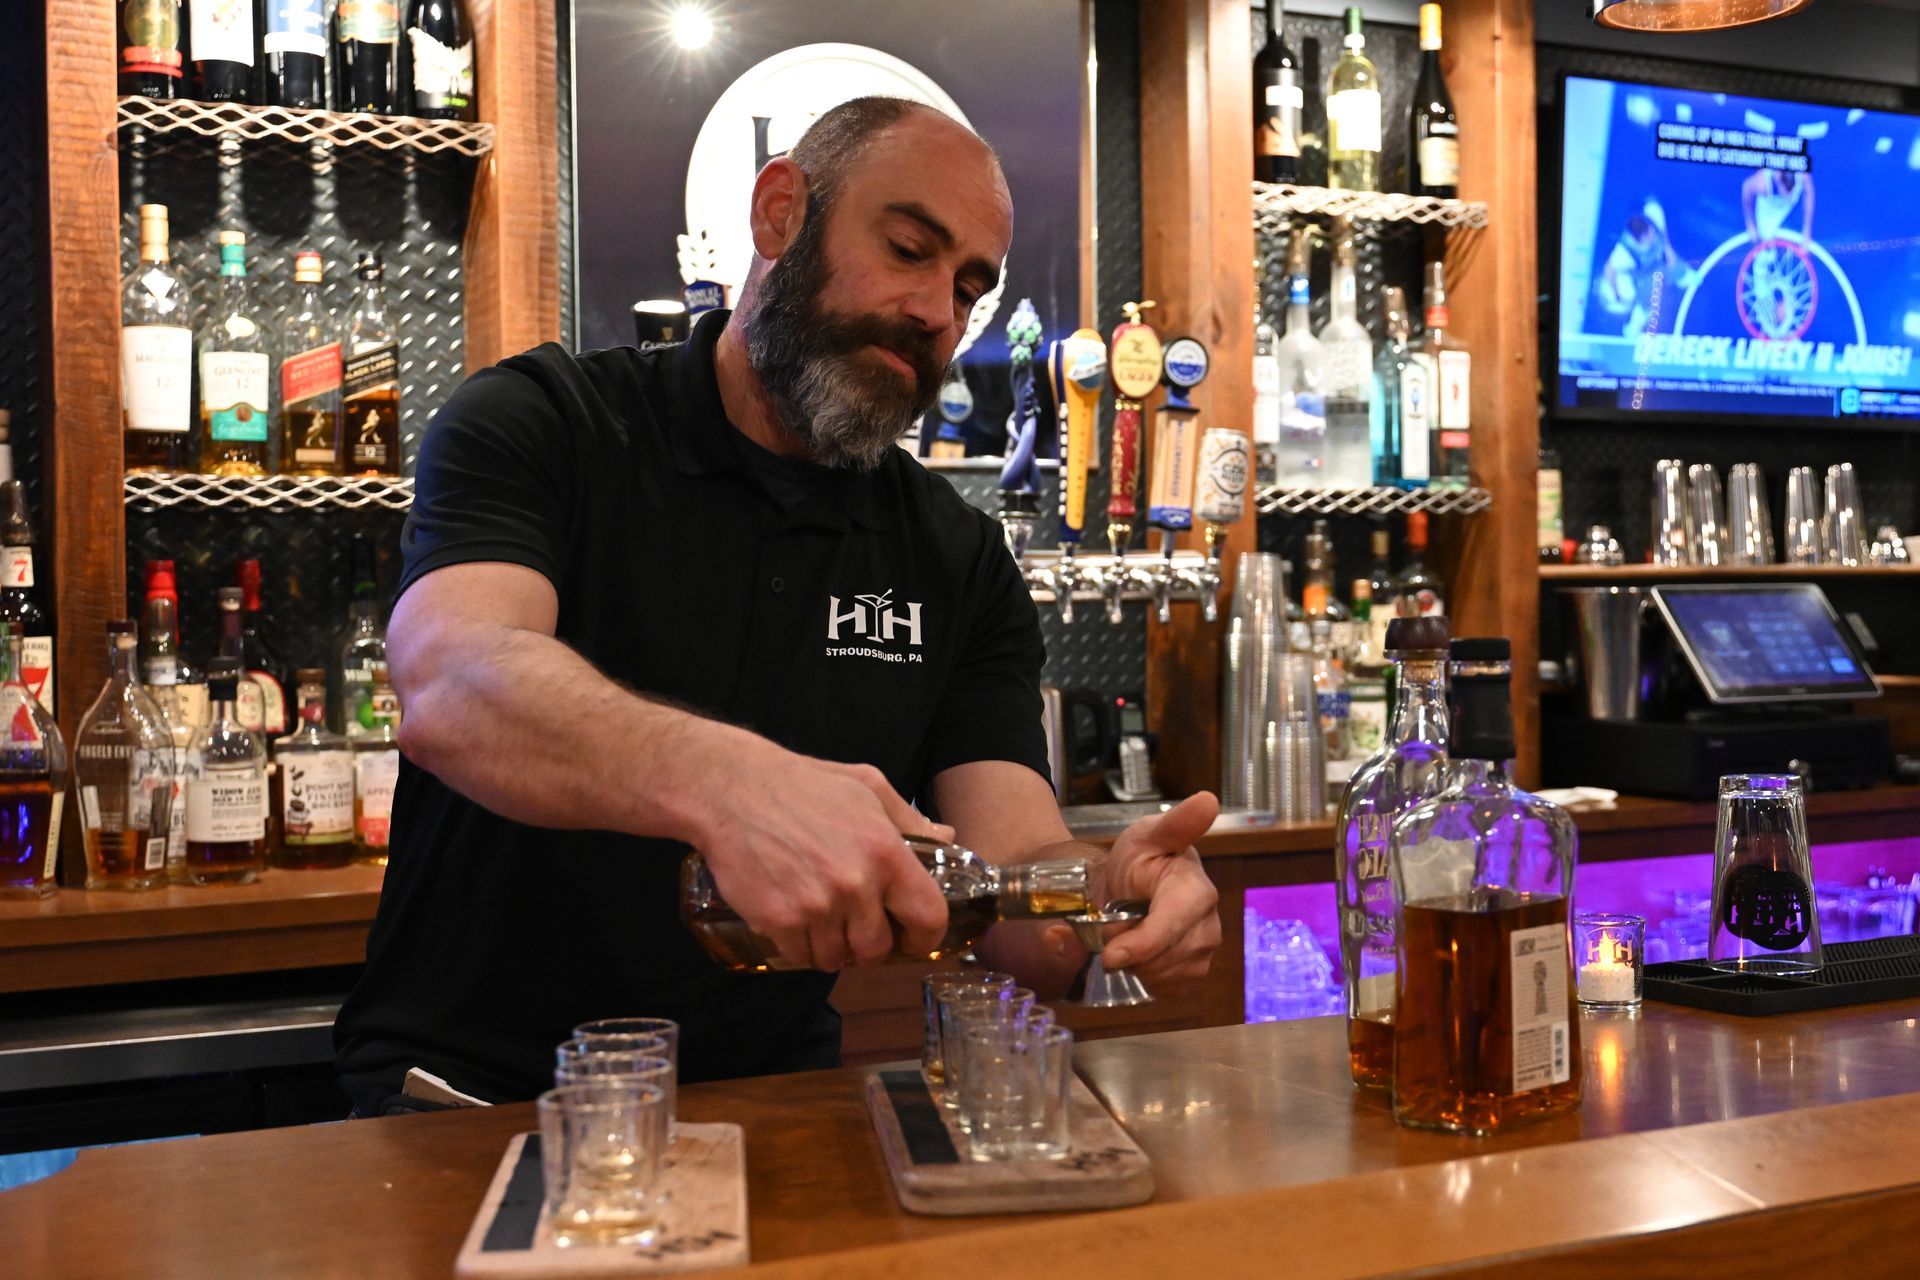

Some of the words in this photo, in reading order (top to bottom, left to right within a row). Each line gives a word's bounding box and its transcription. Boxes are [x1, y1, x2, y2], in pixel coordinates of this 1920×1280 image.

[1632, 333, 1733, 368] DERECK
[1734, 337, 1815, 371] LIVELY
[13, 560, 28, 583] 7
[826, 647, 906, 664] STROUDSBURG,
[909, 653, 923, 663] PA
